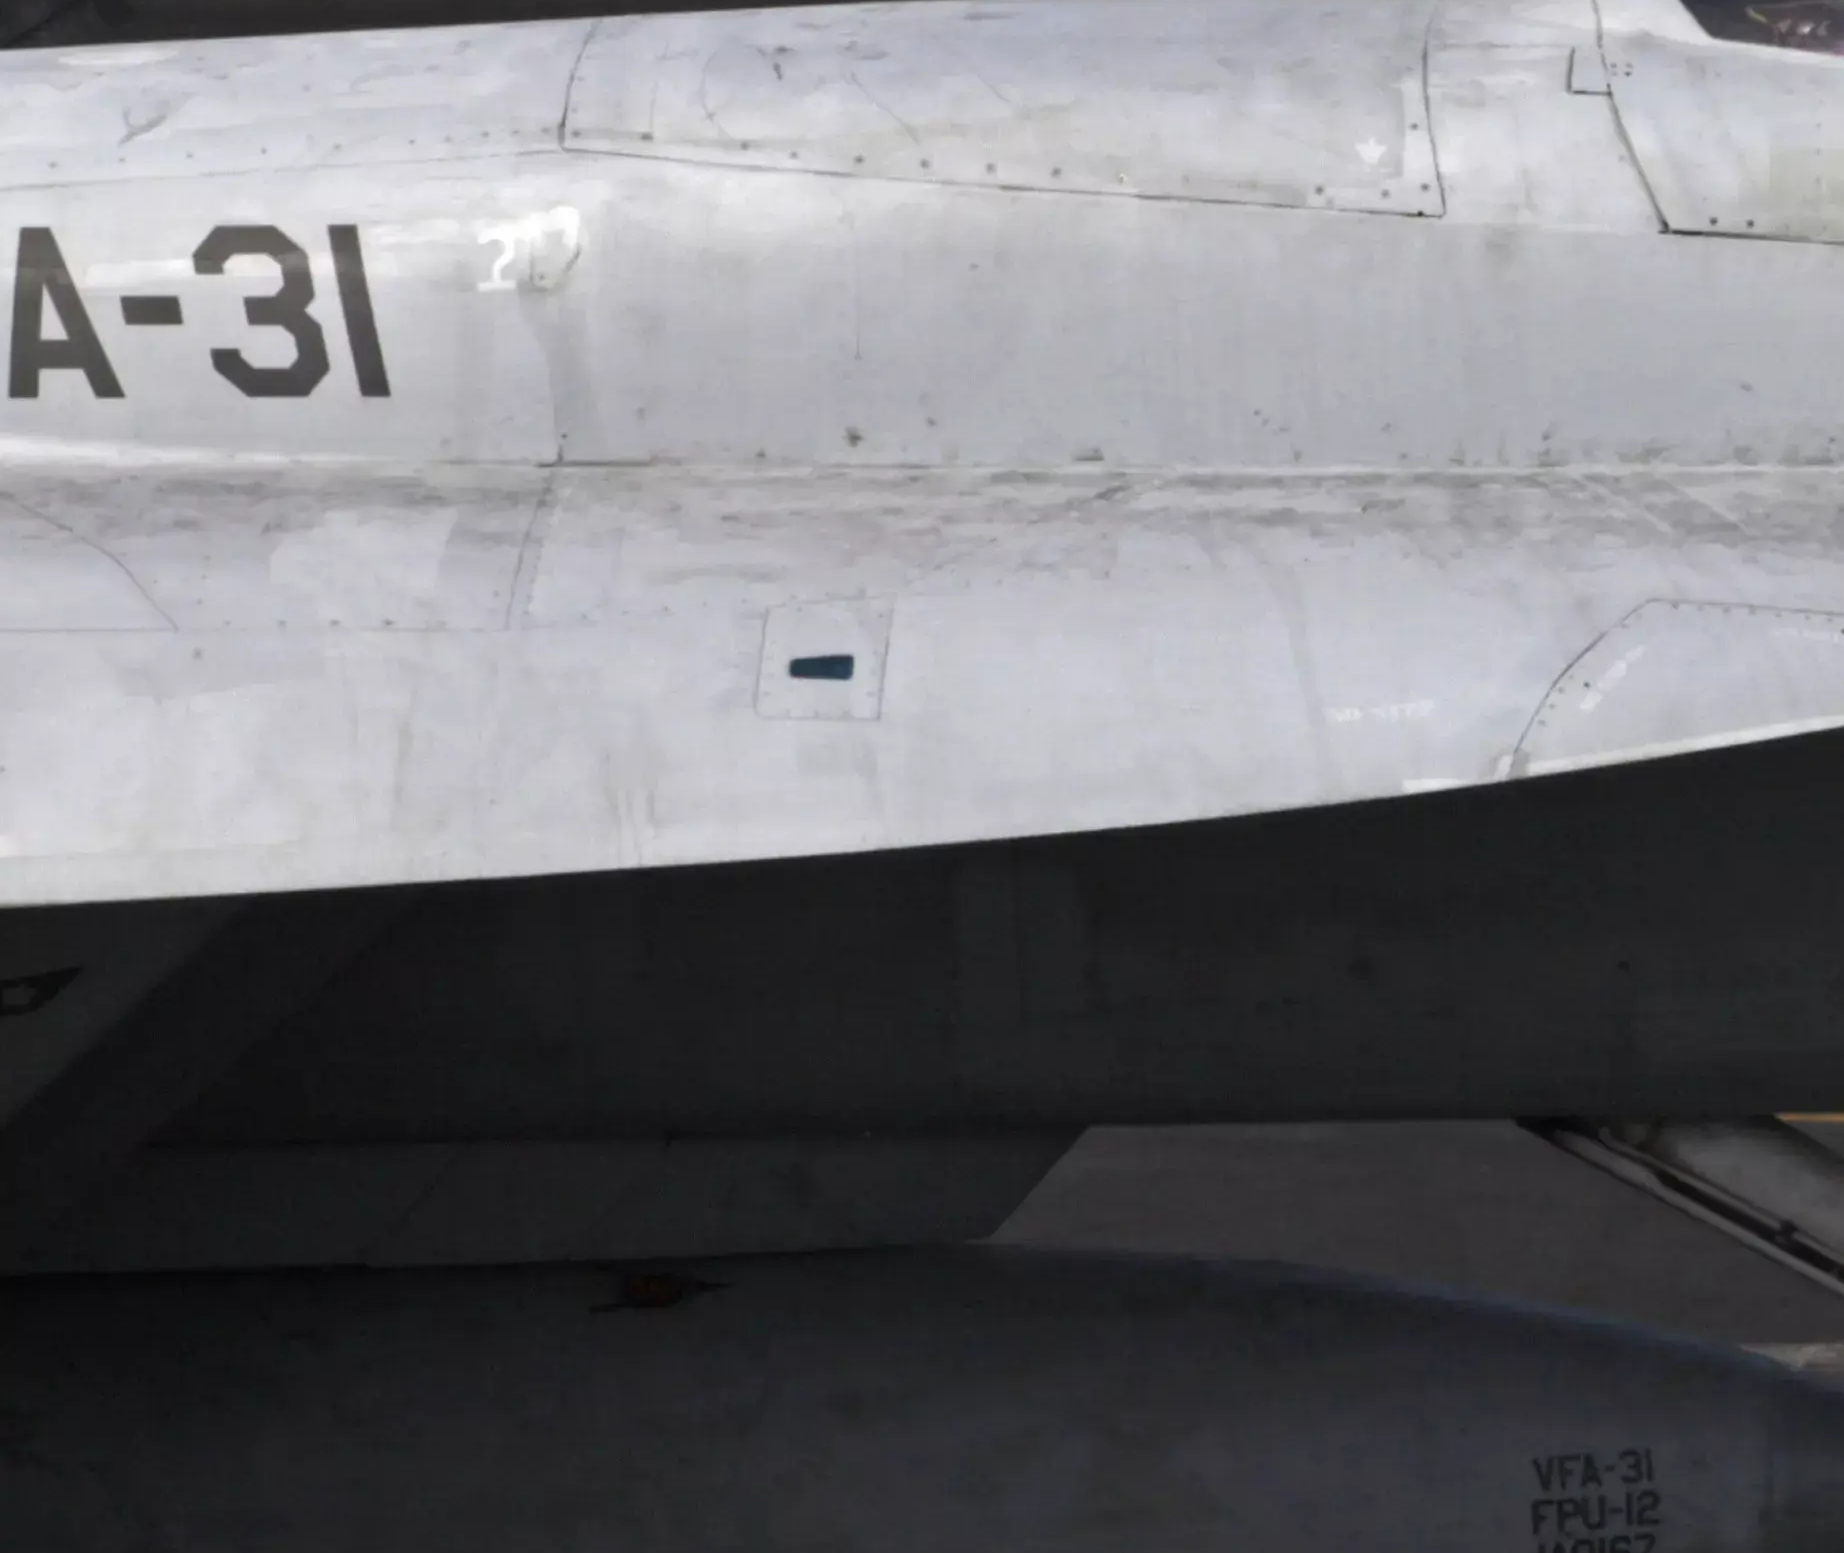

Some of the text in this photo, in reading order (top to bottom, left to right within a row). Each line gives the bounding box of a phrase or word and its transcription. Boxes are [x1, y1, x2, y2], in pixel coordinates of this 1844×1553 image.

[8, 223, 392, 399] A-31
[1531, 1447, 1655, 1491] VFA-31
[1530, 1489, 1663, 1535] FPU-12
